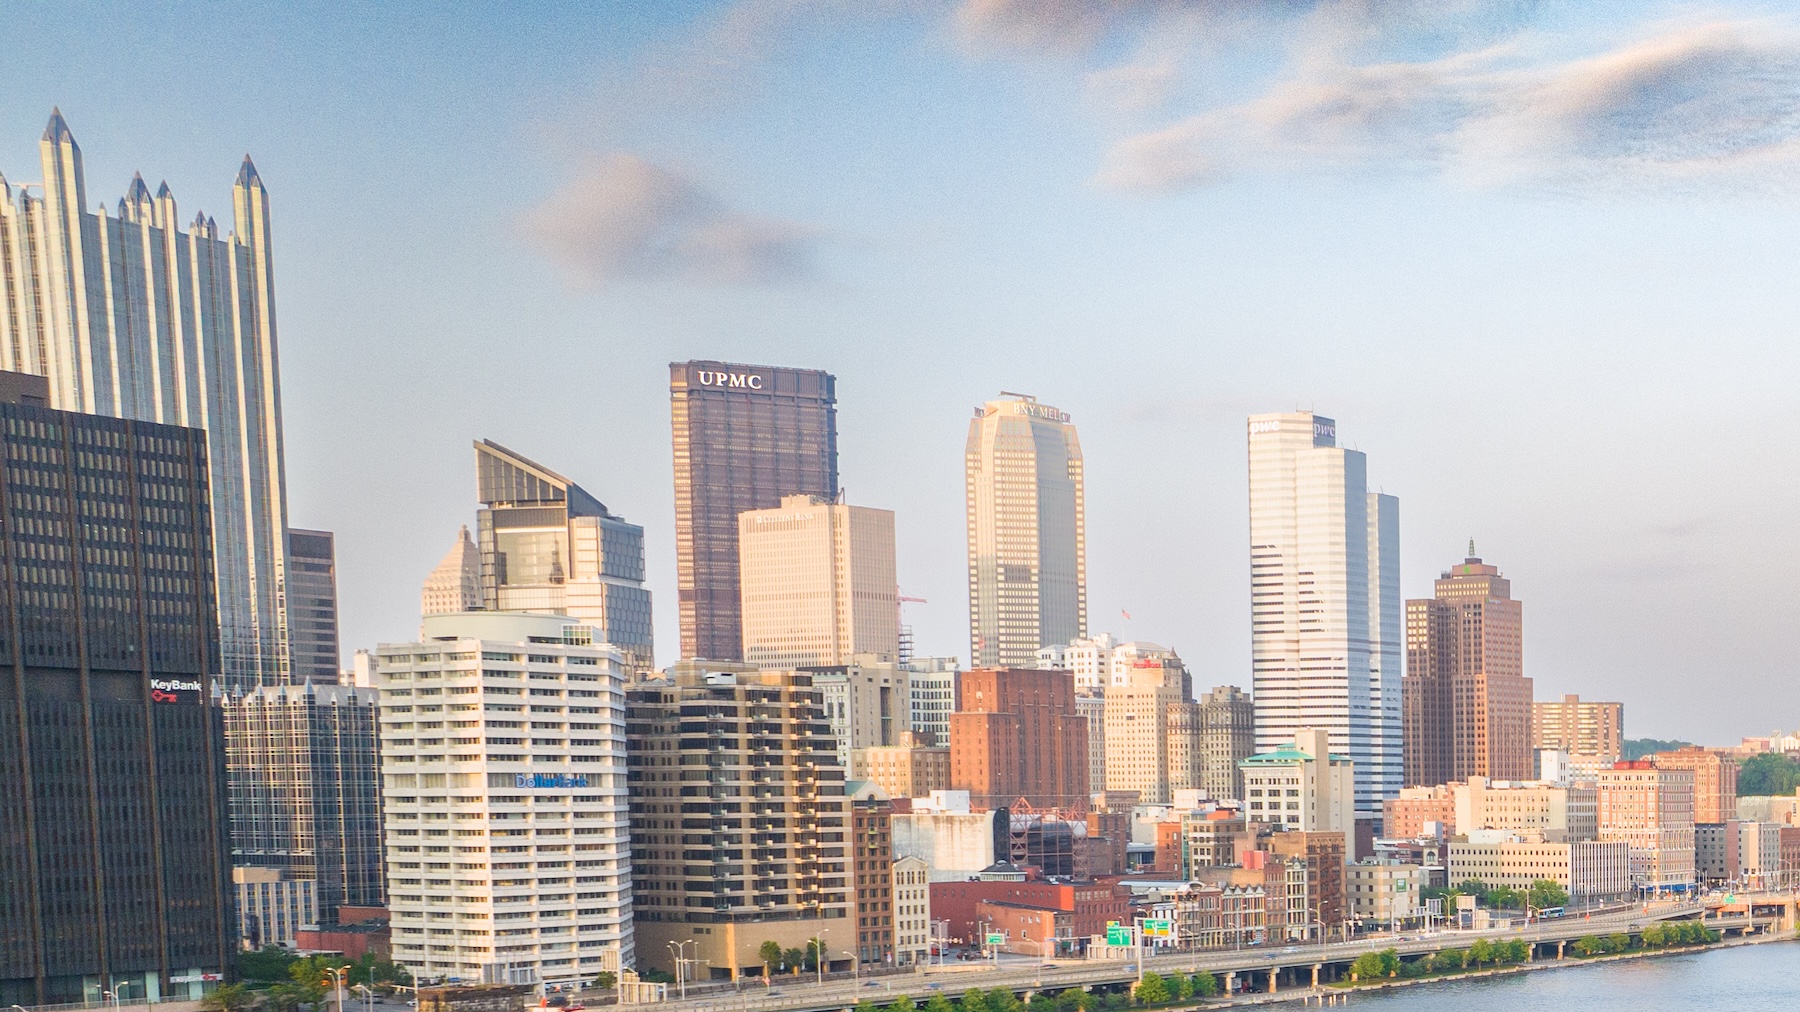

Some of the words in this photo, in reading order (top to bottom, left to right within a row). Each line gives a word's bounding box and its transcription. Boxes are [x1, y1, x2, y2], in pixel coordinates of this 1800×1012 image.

[698, 371, 762, 390] UPMC
[1013, 403, 1035, 416] BNY
[1250, 420, 1280, 436] pwc
[1314, 424, 1335, 437] pwc
[151, 679, 202, 692] KeyBank
